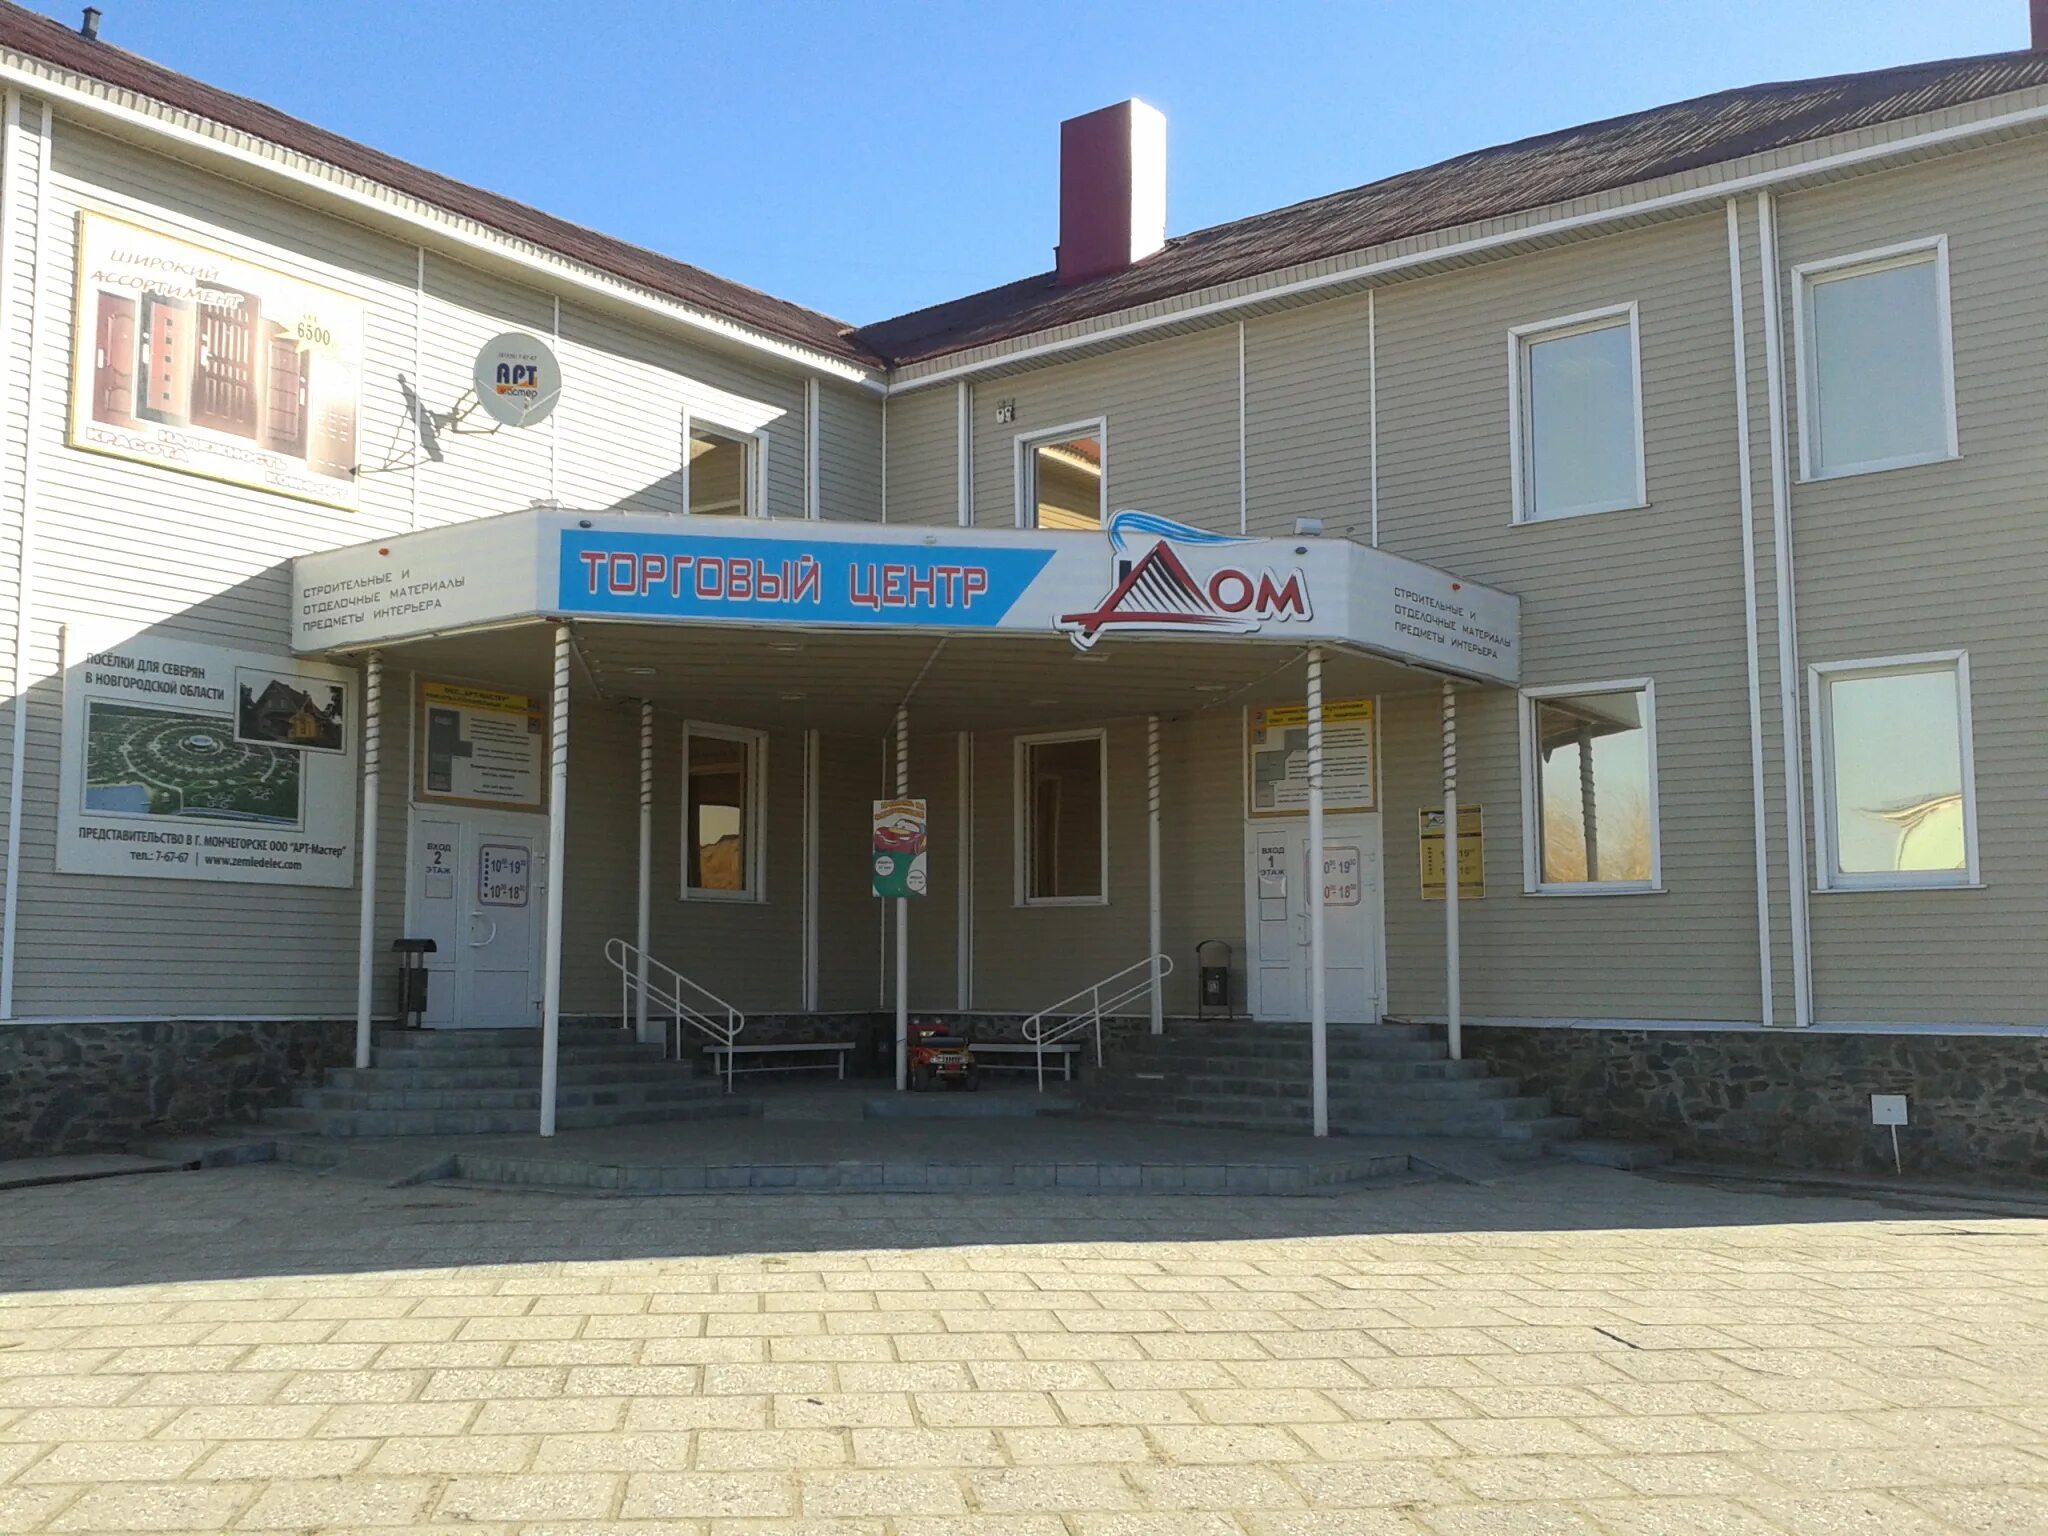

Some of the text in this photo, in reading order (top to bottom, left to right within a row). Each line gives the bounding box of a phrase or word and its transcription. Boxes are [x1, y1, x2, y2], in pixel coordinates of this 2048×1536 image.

[110, 249, 219, 281] ШИРОКИЙ
[91, 270, 245, 309] АССОРТИМЕНТ
[297, 321, 331, 346] 6500
[496, 363, 537, 386] АРТ
[86, 427, 190, 463] КРАСОТА
[303, 568, 410, 599] СТРОИТЕЛЬНЫЕ И
[579, 551, 989, 611] ТОРГОВЫЙ ЦЕНТР
[303, 576, 465, 615] ОТДЕЛОЧНЫЕ МАТЕРИАЛЫ
[1394, 587, 1477, 621] СТРОИТЕЛЬНЫЕ И
[303, 599, 442, 632] ПРЕДМЕТЫ ИНТЕРЬЕРА
[1394, 604, 1511, 647] ОТДЕЛОЧНЫЕ МАТЕРИАЛЫ
[1394, 621, 1498, 659] ПРЕДМЕТЫ ИНТЕРЬЕРА
[86, 652, 206, 680] ПОСЁЛКИ ДЛЯ СЕВЕРЯН
[85, 671, 225, 701] В НОВГОРОДСКОЙ ОБЛАСТИ
[78, 826, 185, 845] ПРЕДСТАВИТЕЛЬСТВО
[186, 834, 193, 846] В
[194, 835, 202, 847] Г.
[204, 835, 268, 851] МОНЧЕГОРСКЕ
[269, 840, 288, 852] ООО
[427, 843, 451, 853] ВХОД
[1261, 847, 1285, 856] ВХОД
[155, 850, 189, 863] 7-67-67
[204, 855, 302, 870] www.zemledelec.com
[425, 866, 451, 874] ЭТАЖ
[434, 851, 442, 864] 2
[1268, 856, 1274, 868] 1
[1260, 869, 1285, 877] ЭТАЖ
